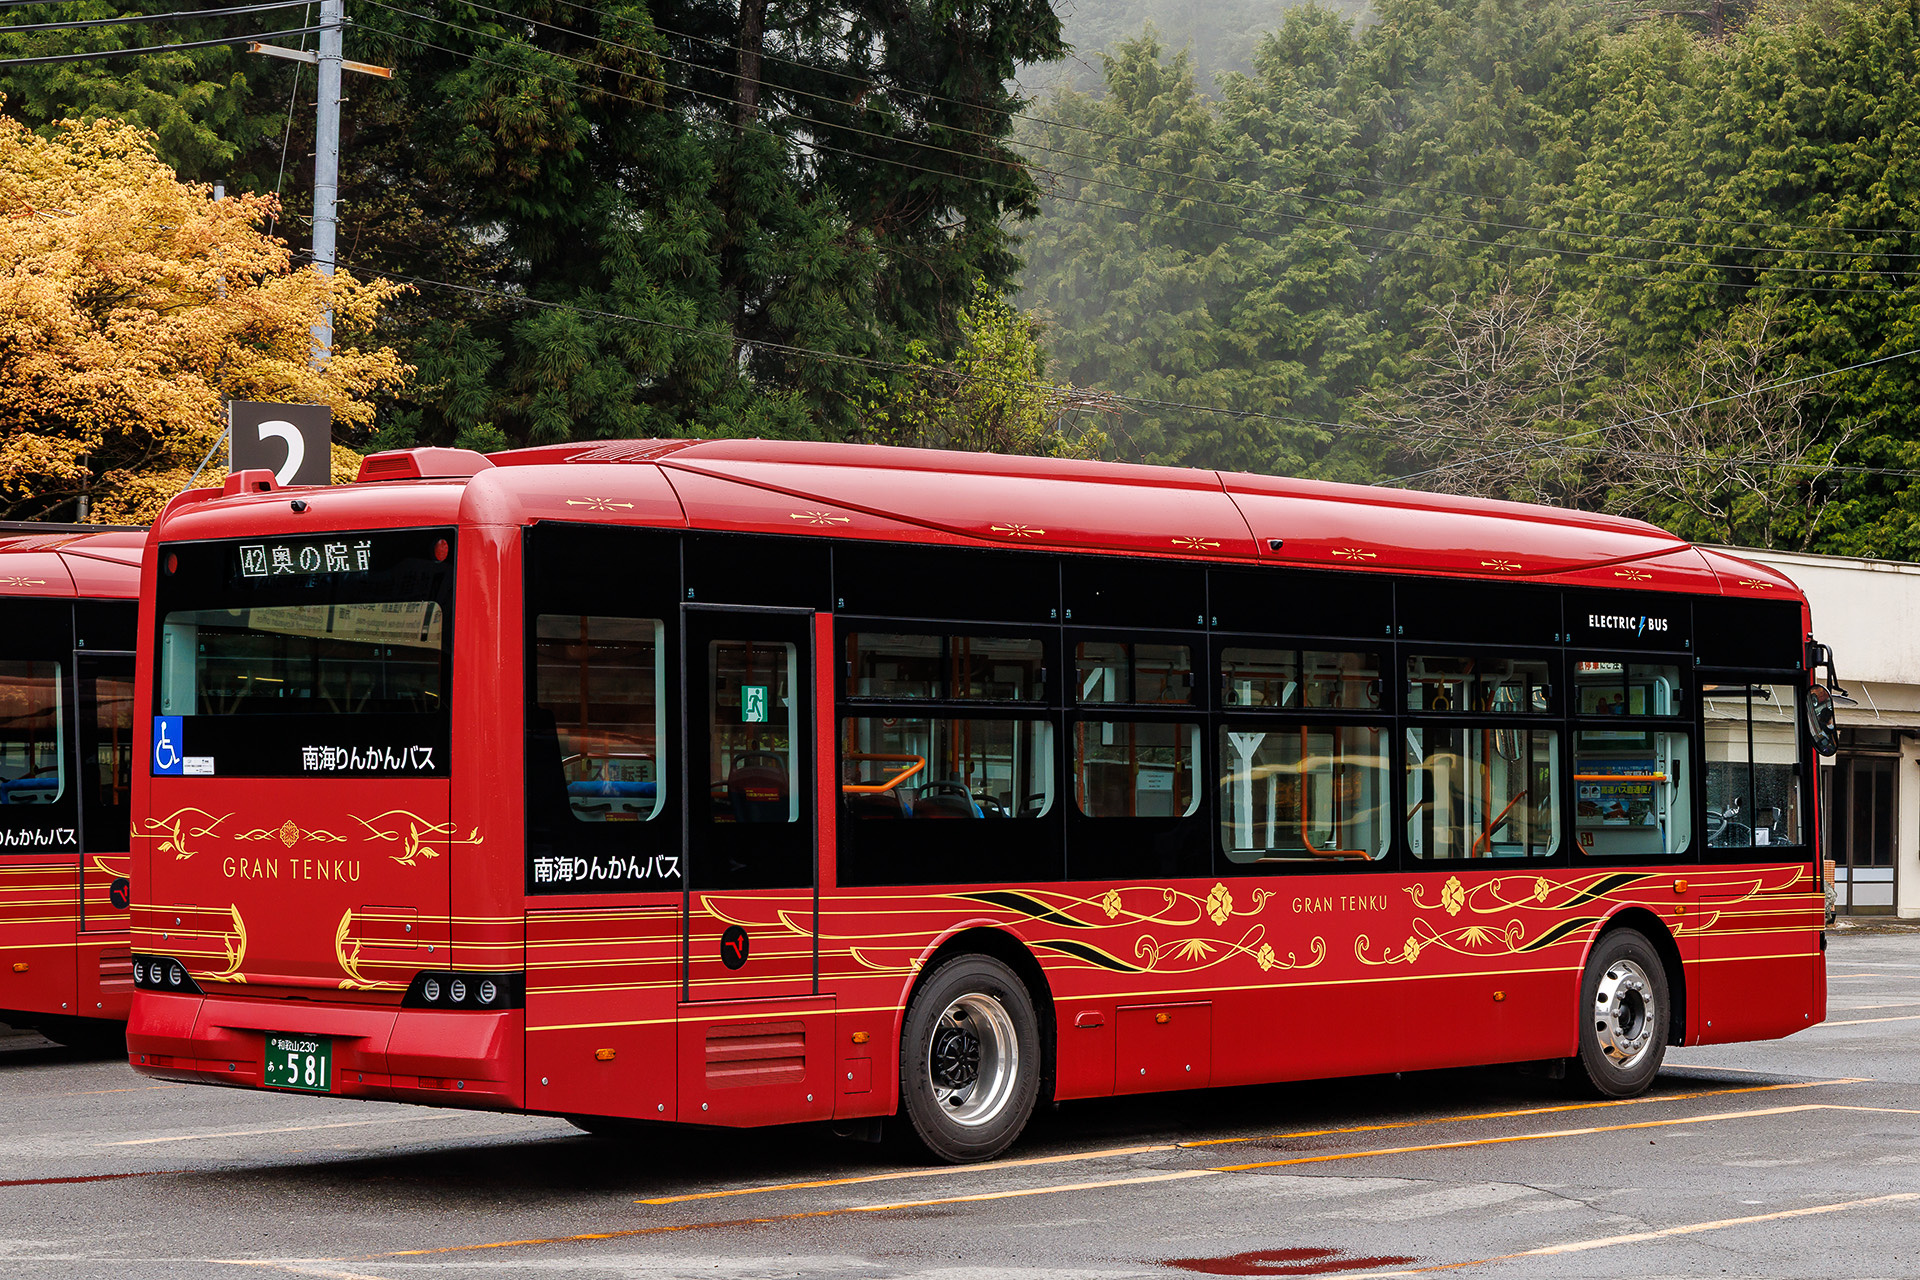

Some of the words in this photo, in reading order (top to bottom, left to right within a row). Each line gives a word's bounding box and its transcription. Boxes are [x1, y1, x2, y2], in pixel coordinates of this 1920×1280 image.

[257, 420, 305, 487] 2
[244, 550, 266, 572] 42
[271, 540, 371, 575] 奥の院前
[1588, 614, 1636, 629] ELECTRIC
[1648, 618, 1668, 631] BUS
[302, 745, 435, 770] 南海りんかんバス
[223, 857, 278, 880] GRAN
[290, 859, 360, 883] TENKU
[533, 854, 681, 883] 南海りんかんバス
[1292, 897, 1332, 914] GRAN
[1340, 895, 1387, 911] TENKU
